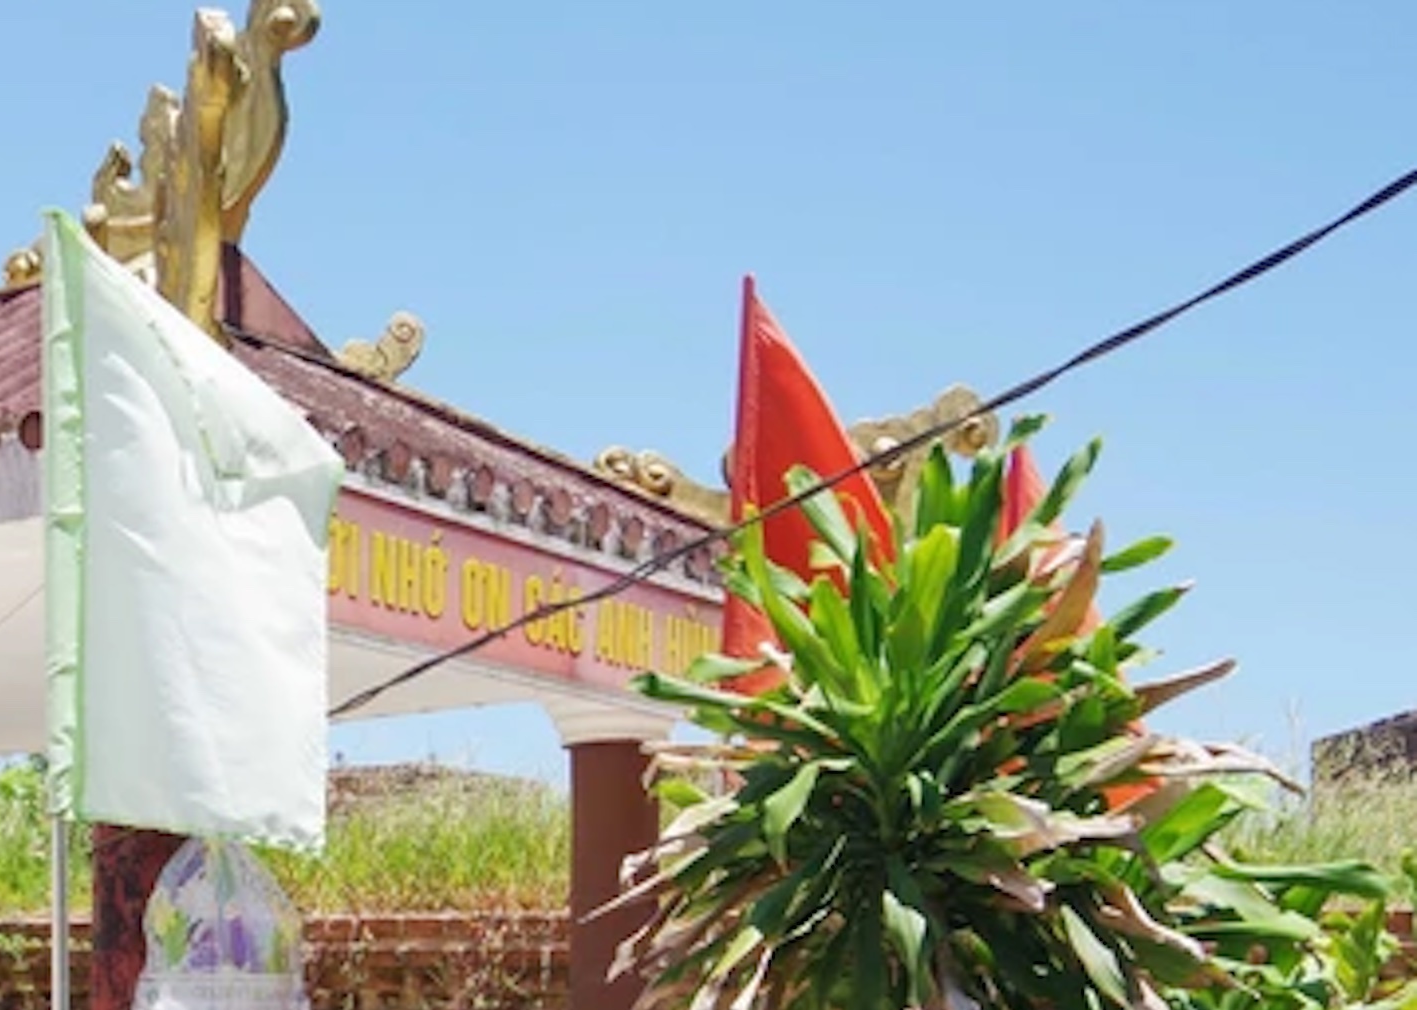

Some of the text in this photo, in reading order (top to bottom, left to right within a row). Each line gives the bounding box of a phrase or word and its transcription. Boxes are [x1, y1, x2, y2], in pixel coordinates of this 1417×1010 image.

[370, 528, 449, 620] NHỚ
[460, 556, 512, 637] ƠN
[523, 564, 585, 659] CÁC
[595, 597, 653, 671] ANH
